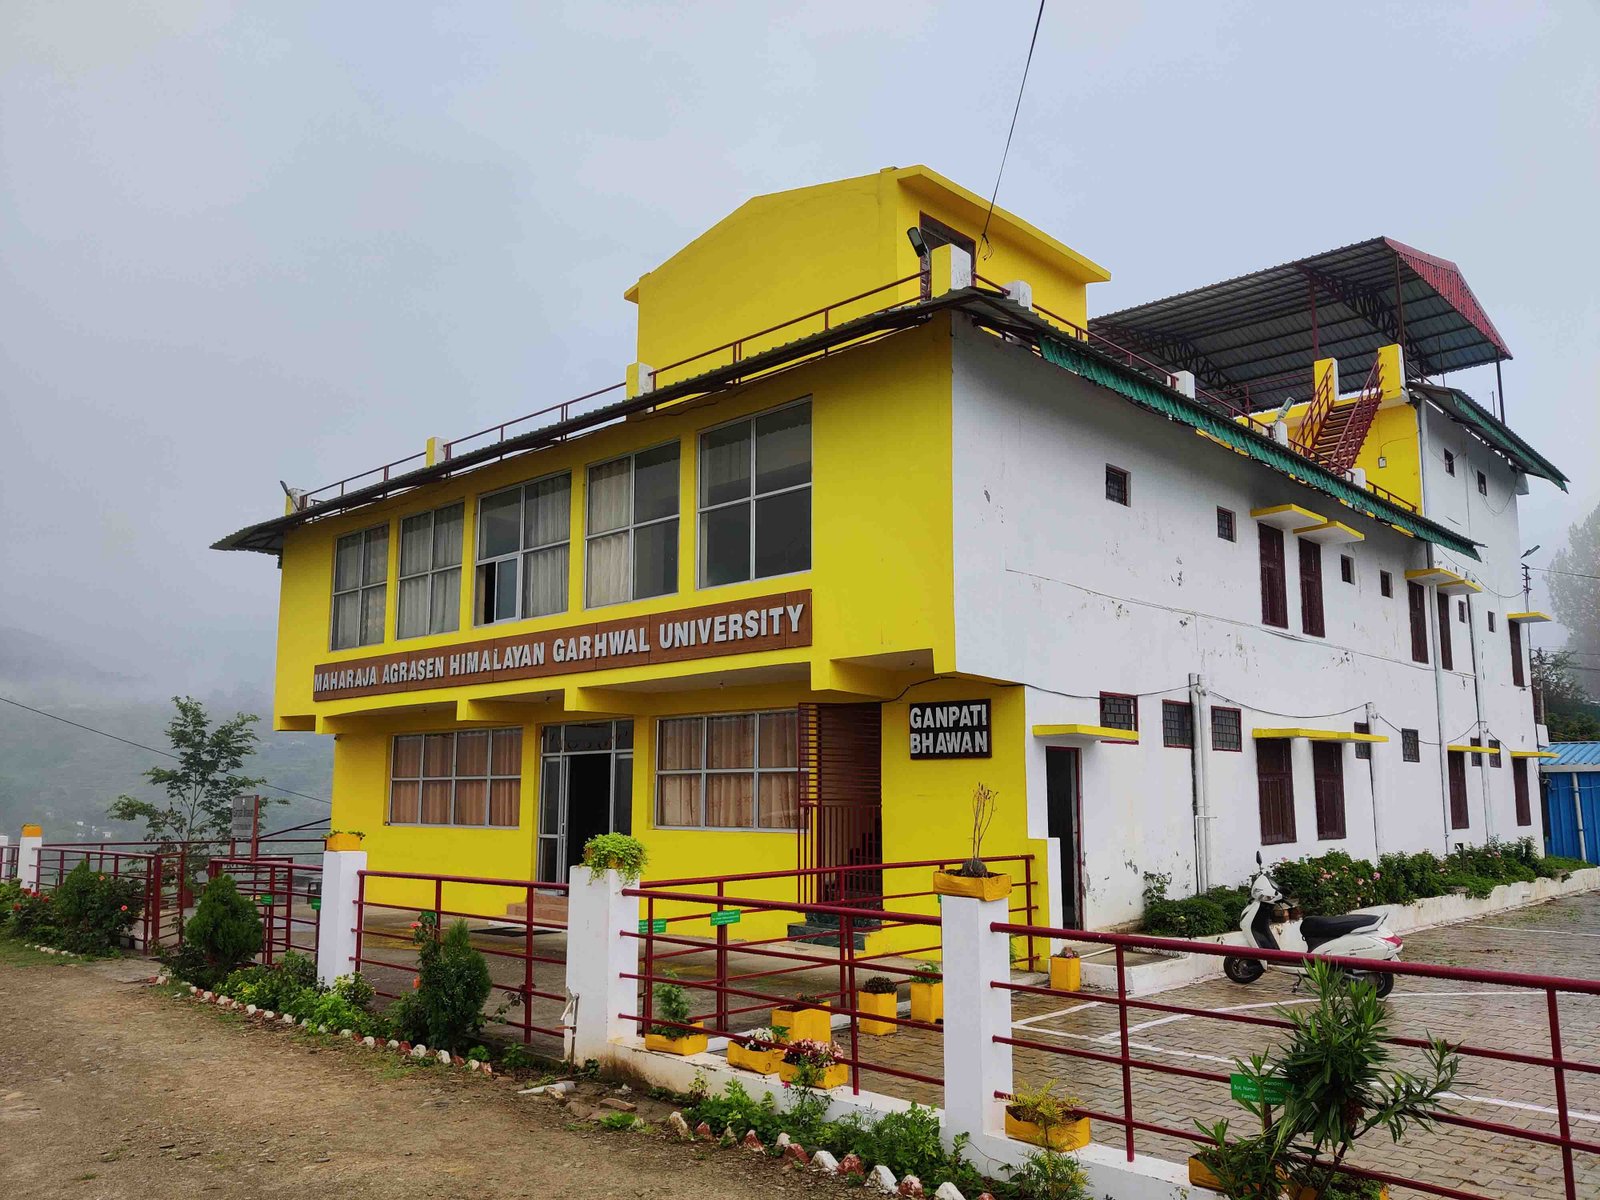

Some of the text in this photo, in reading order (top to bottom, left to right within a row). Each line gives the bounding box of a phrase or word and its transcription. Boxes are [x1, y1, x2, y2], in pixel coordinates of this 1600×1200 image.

[314, 604, 804, 692] MAHARAJA AGRASEN HIMALAYAN GARHWAL UNIVERSITY
[909, 704, 987, 729] GANPATI
[910, 730, 988, 754] BHAWAN
